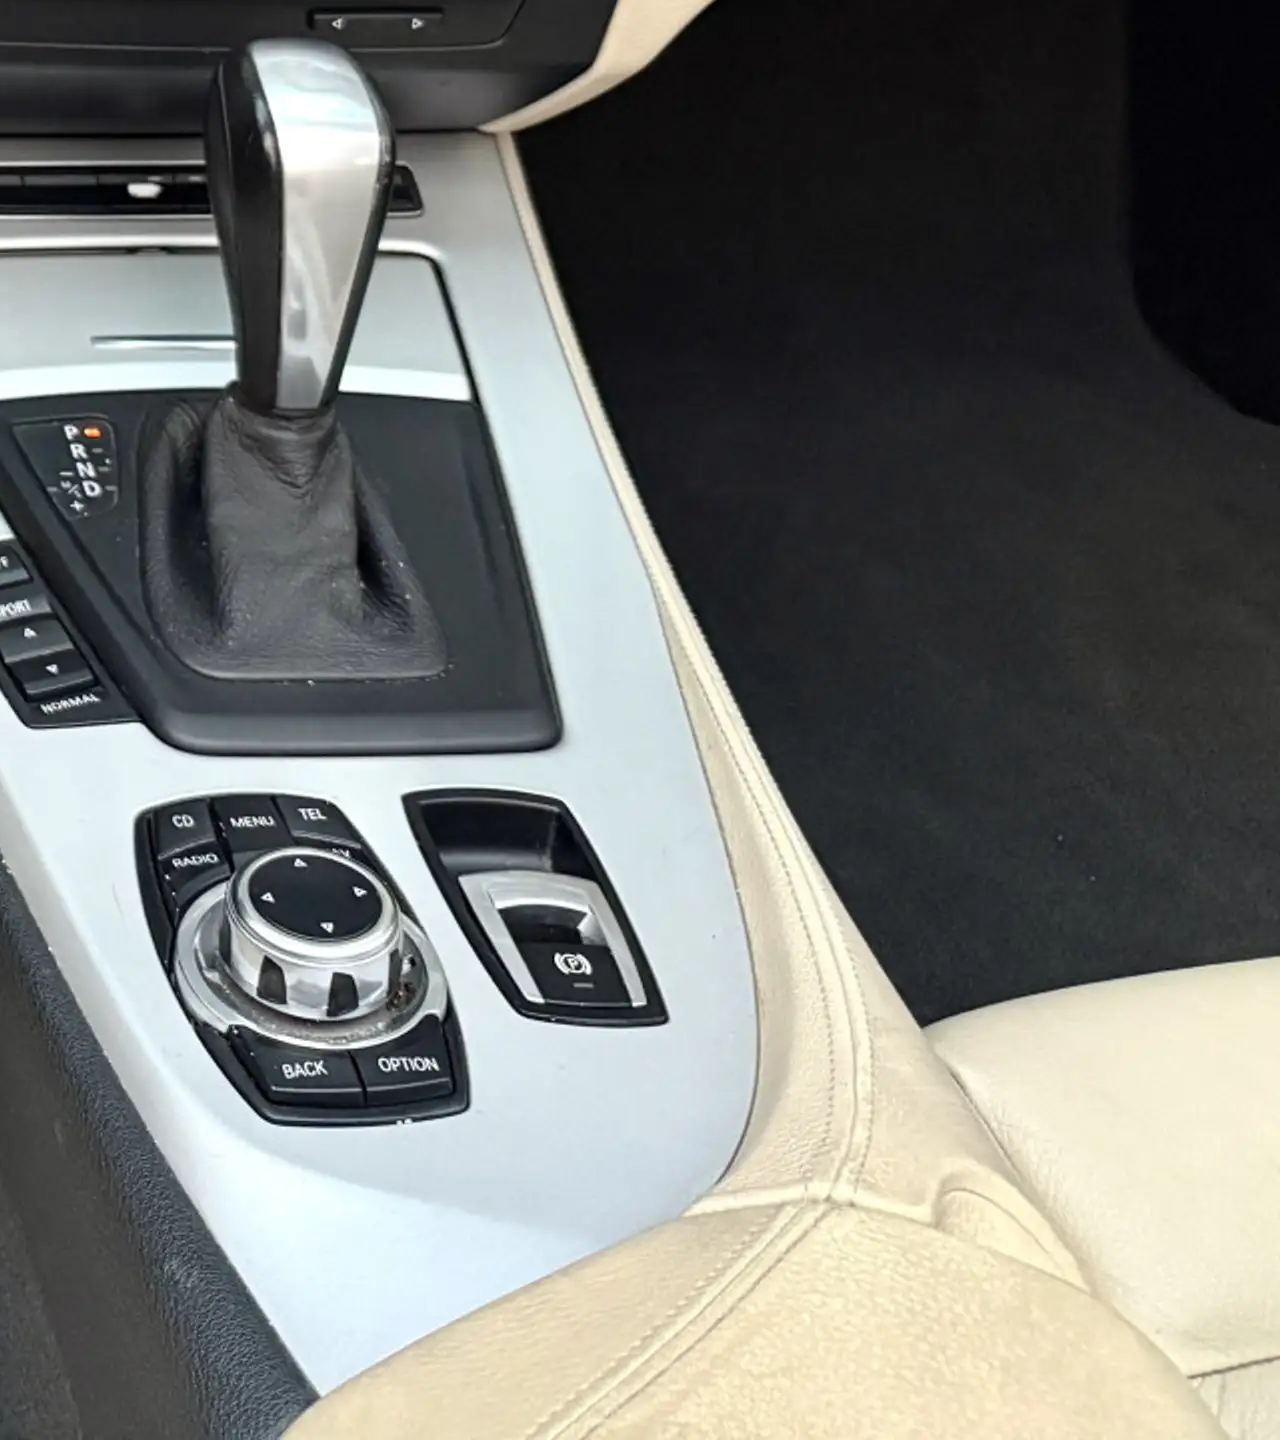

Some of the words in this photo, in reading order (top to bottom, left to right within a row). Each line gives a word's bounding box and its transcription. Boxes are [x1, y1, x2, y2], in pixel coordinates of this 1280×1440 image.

[63, 423, 80, 440] P
[70, 444, 89, 460] R
[76, 462, 97, 478] N
[82, 480, 102, 497] D
[40, 692, 101, 715] NORMAL
[171, 813, 195, 828] CD
[229, 815, 276, 828] MENU
[298, 807, 327, 821] TEL
[172, 851, 219, 869] RADIO
[281, 1059, 329, 1080] BACK
[377, 1056, 440, 1073] OPTION
